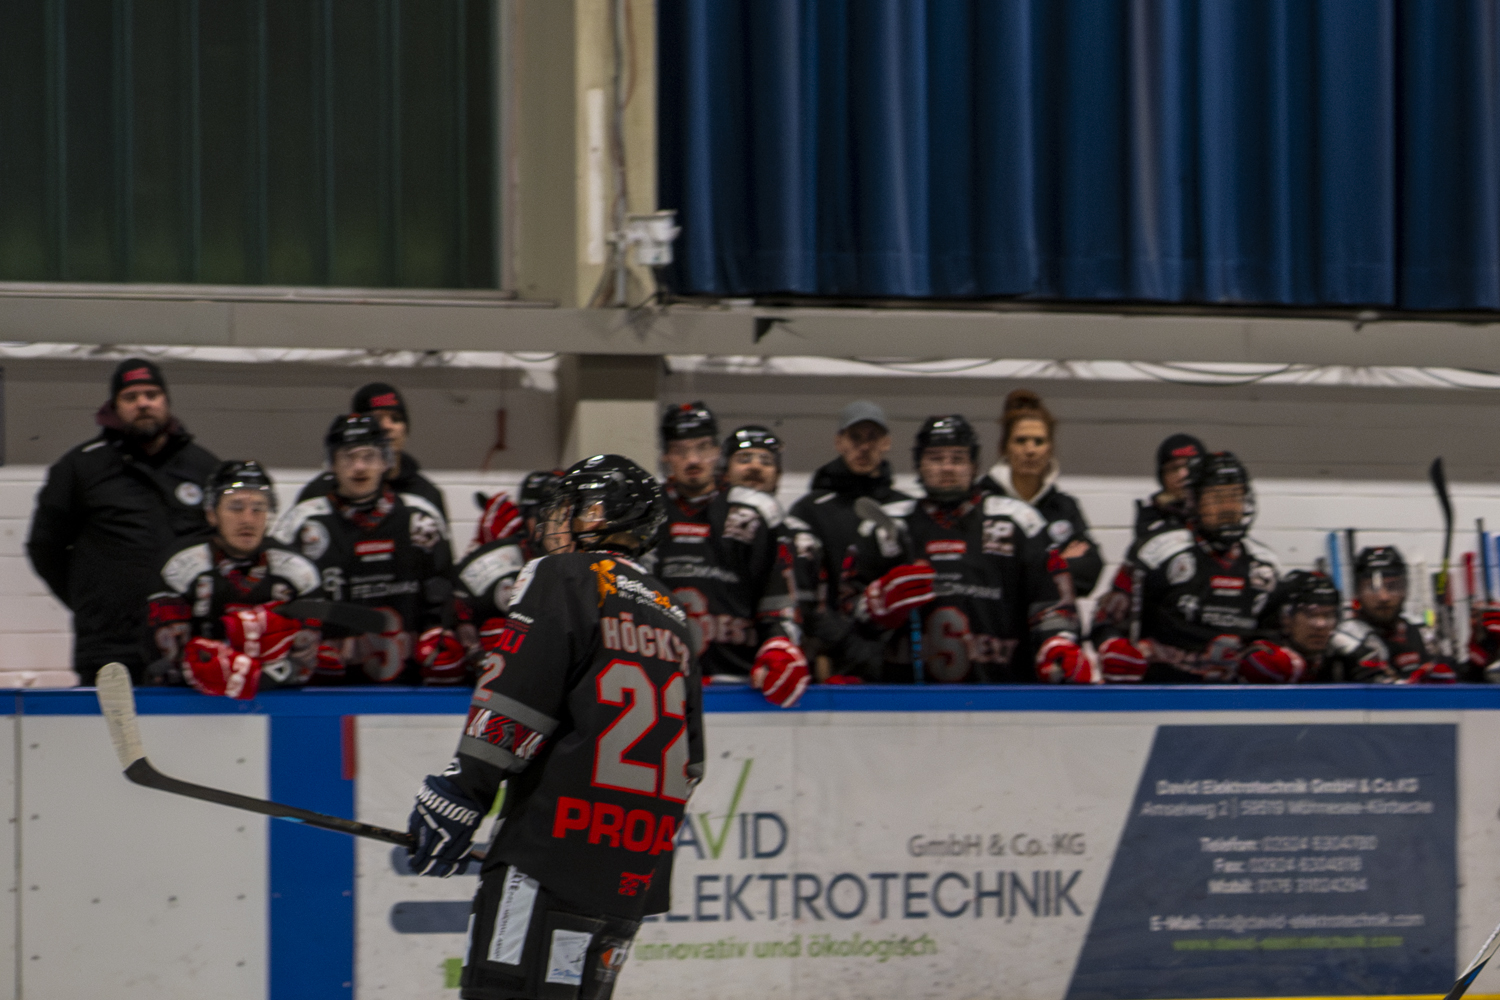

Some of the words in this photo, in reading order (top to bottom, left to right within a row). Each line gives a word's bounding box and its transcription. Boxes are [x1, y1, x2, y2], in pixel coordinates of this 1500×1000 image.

[907, 832, 982, 857] GmbH
[987, 832, 1003, 857] &
[643, 869, 1085, 923] EKTROTECHNIK
[754, 935, 799, 959] und
[807, 931, 939, 962] ökologisch
